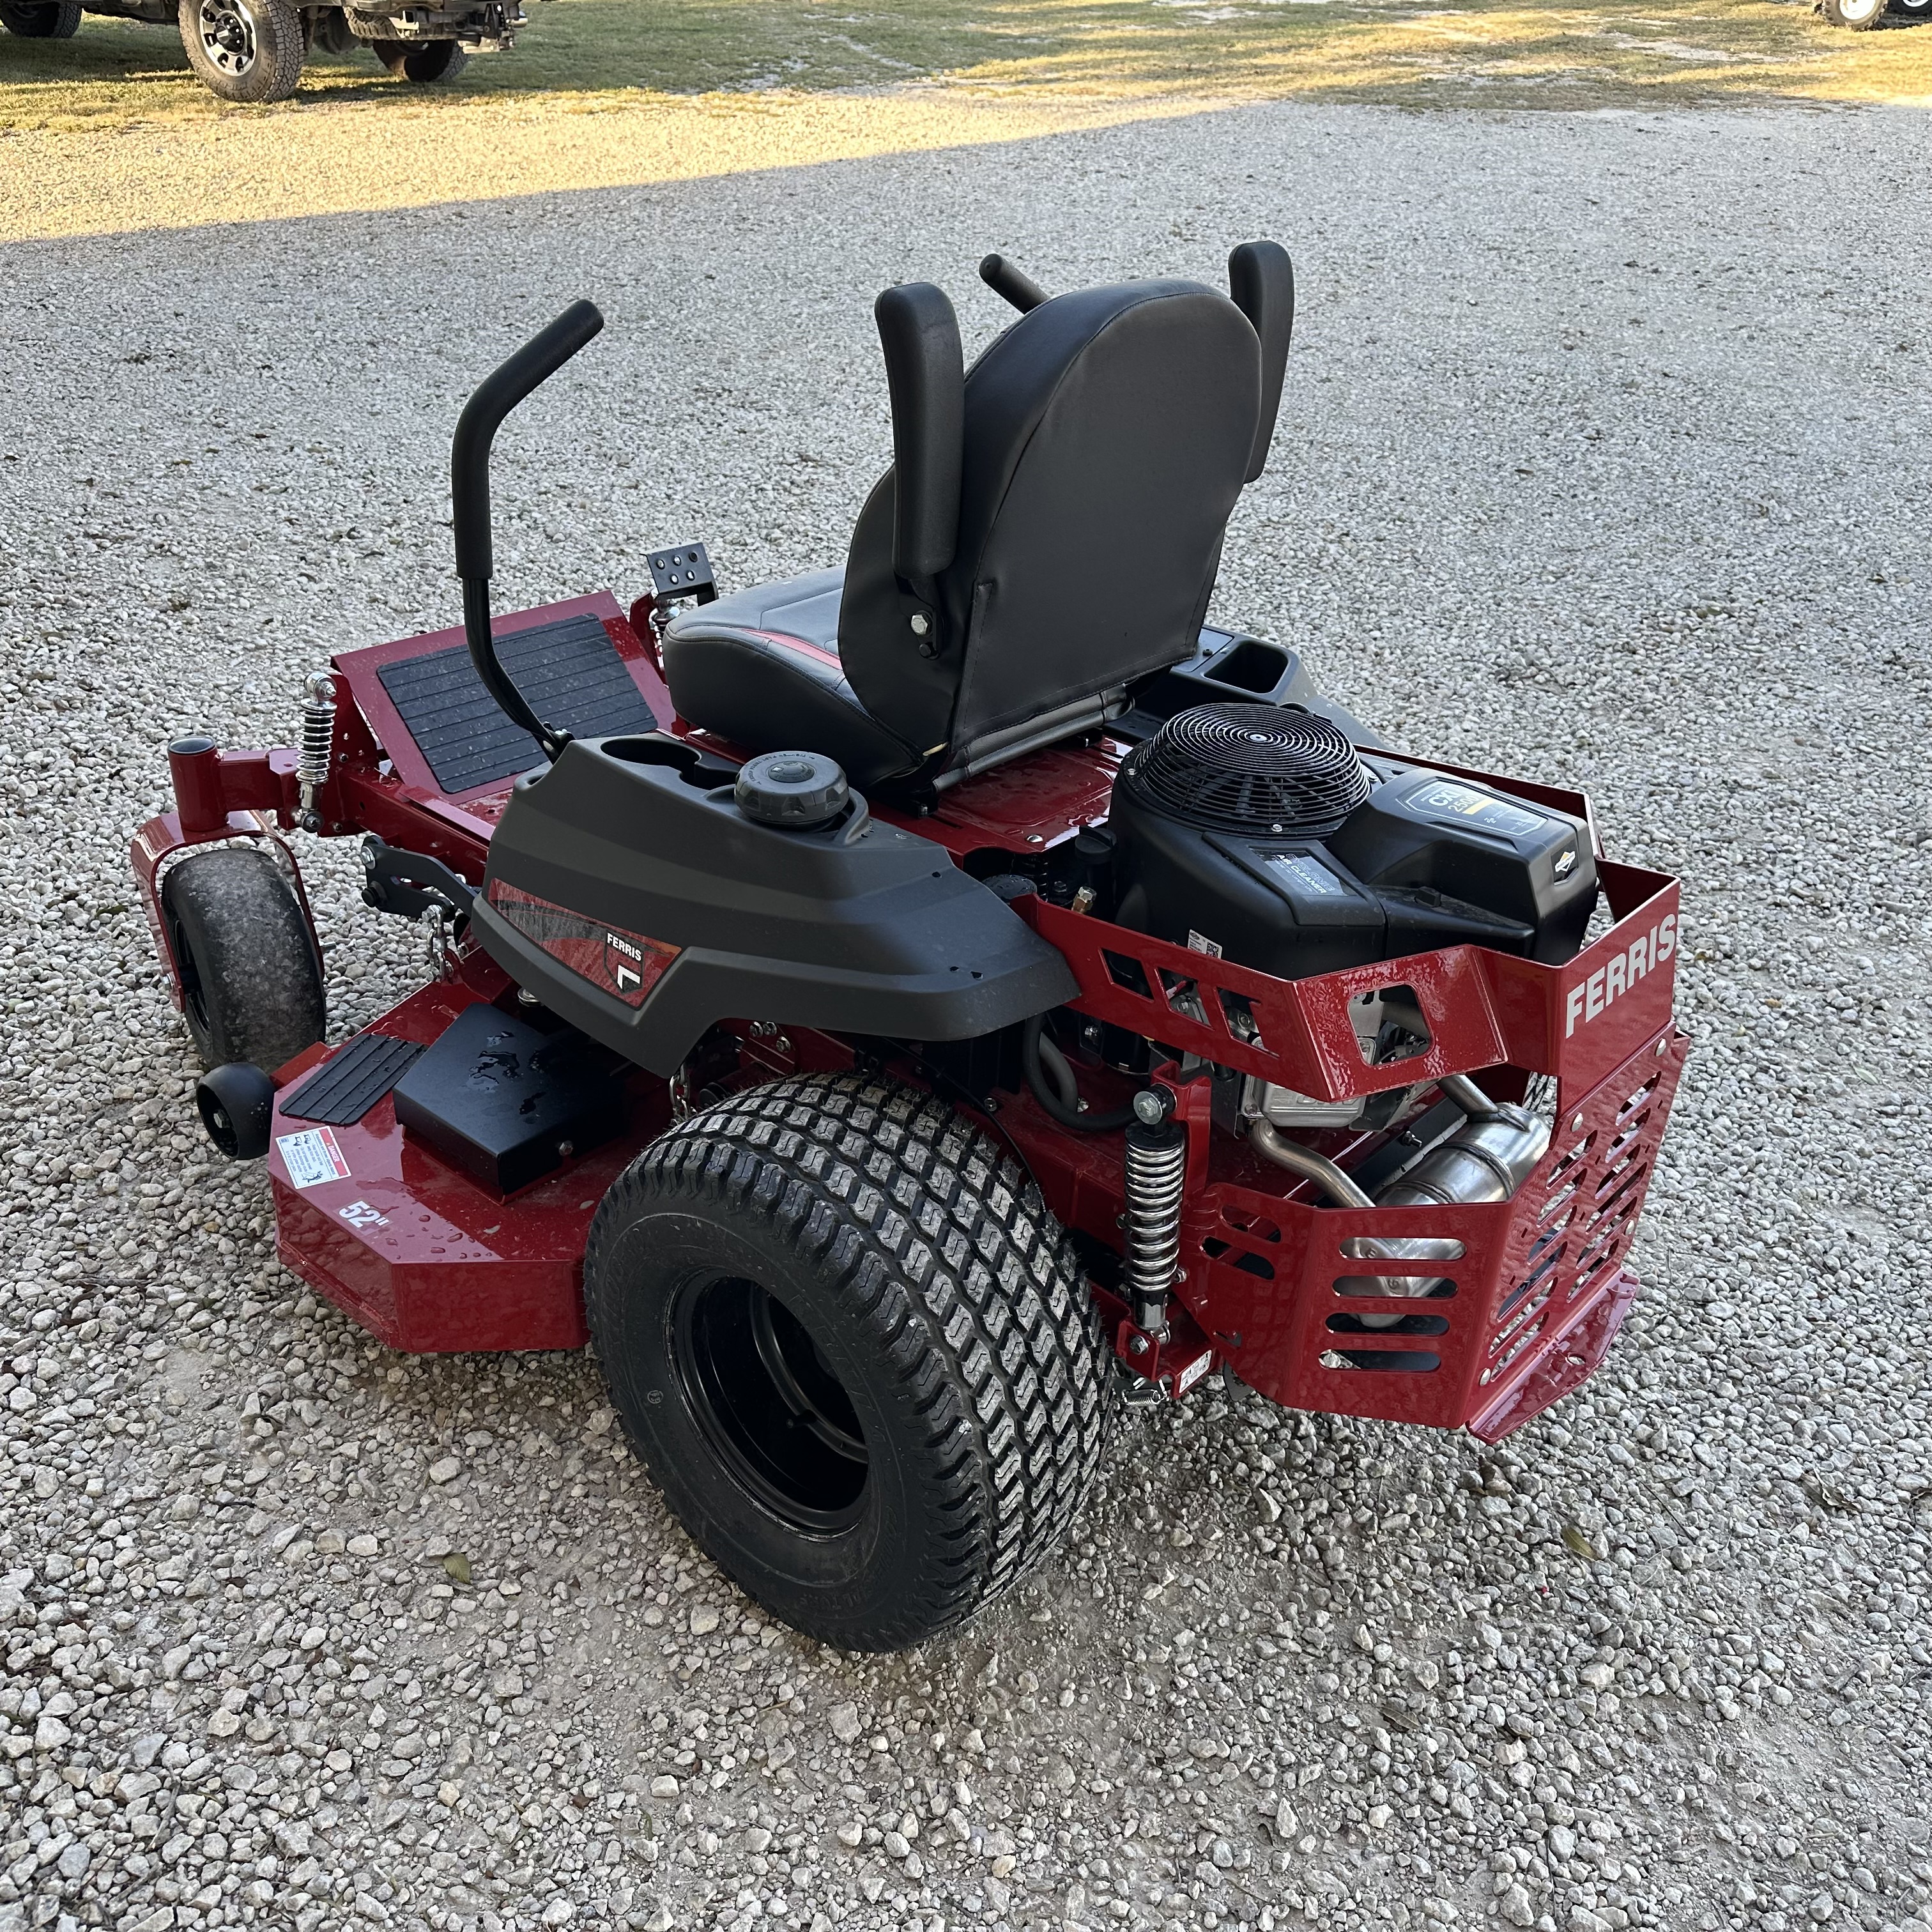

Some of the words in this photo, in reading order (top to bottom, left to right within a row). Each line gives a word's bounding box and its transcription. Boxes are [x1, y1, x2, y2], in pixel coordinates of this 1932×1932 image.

[1448, 795, 1479, 812] 2500
[1276, 855, 1292, 864] AIR
[1291, 866, 1327, 893] CLEANER
[607, 933, 641, 962] FERRIS
[1566, 914, 1676, 1039] FERRIS
